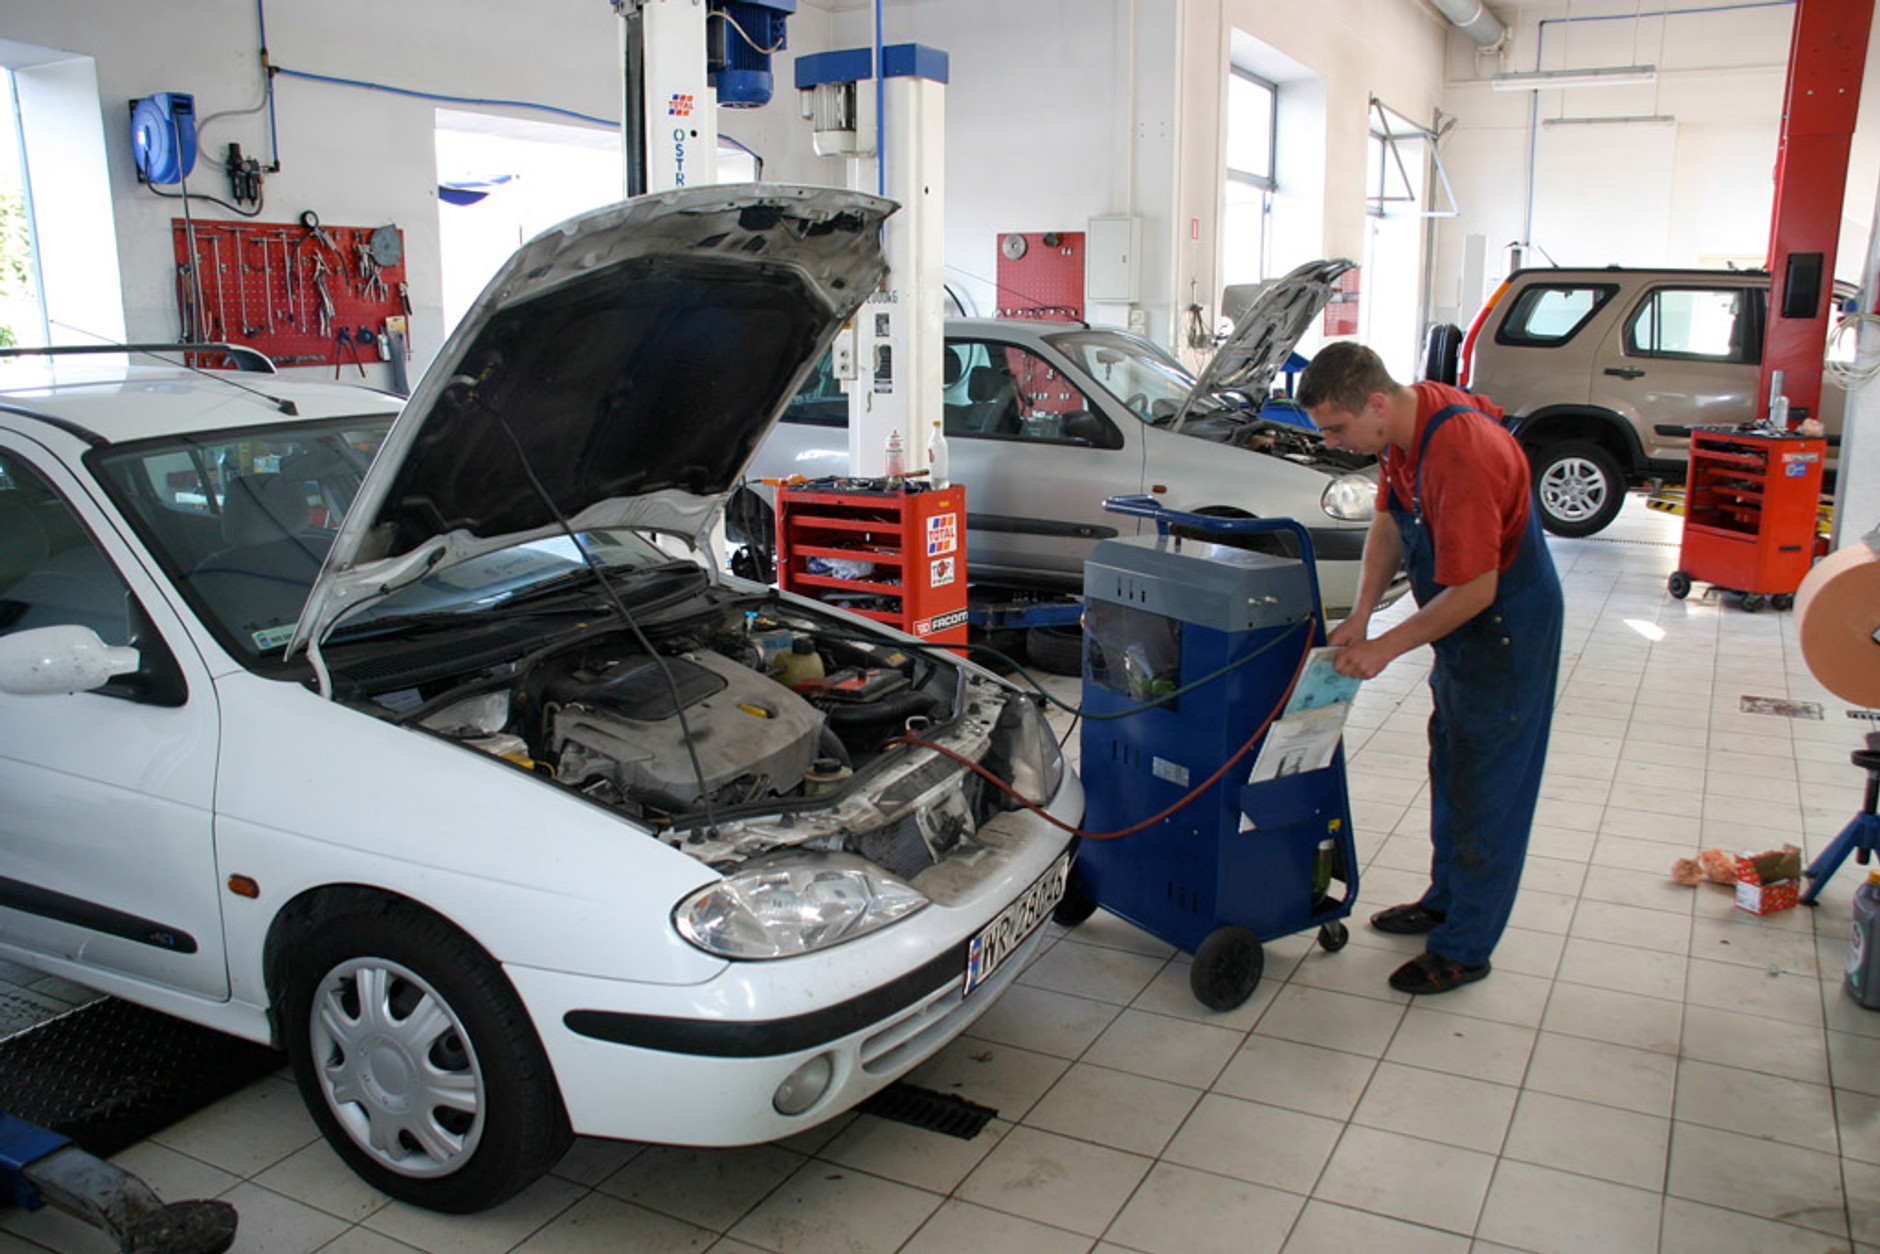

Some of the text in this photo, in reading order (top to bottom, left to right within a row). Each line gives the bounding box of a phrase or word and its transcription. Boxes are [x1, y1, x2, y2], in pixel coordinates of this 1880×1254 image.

[668, 101, 694, 110] TOTAL
[929, 527, 955, 541] TOTAL
[932, 610, 969, 632] FACOM
